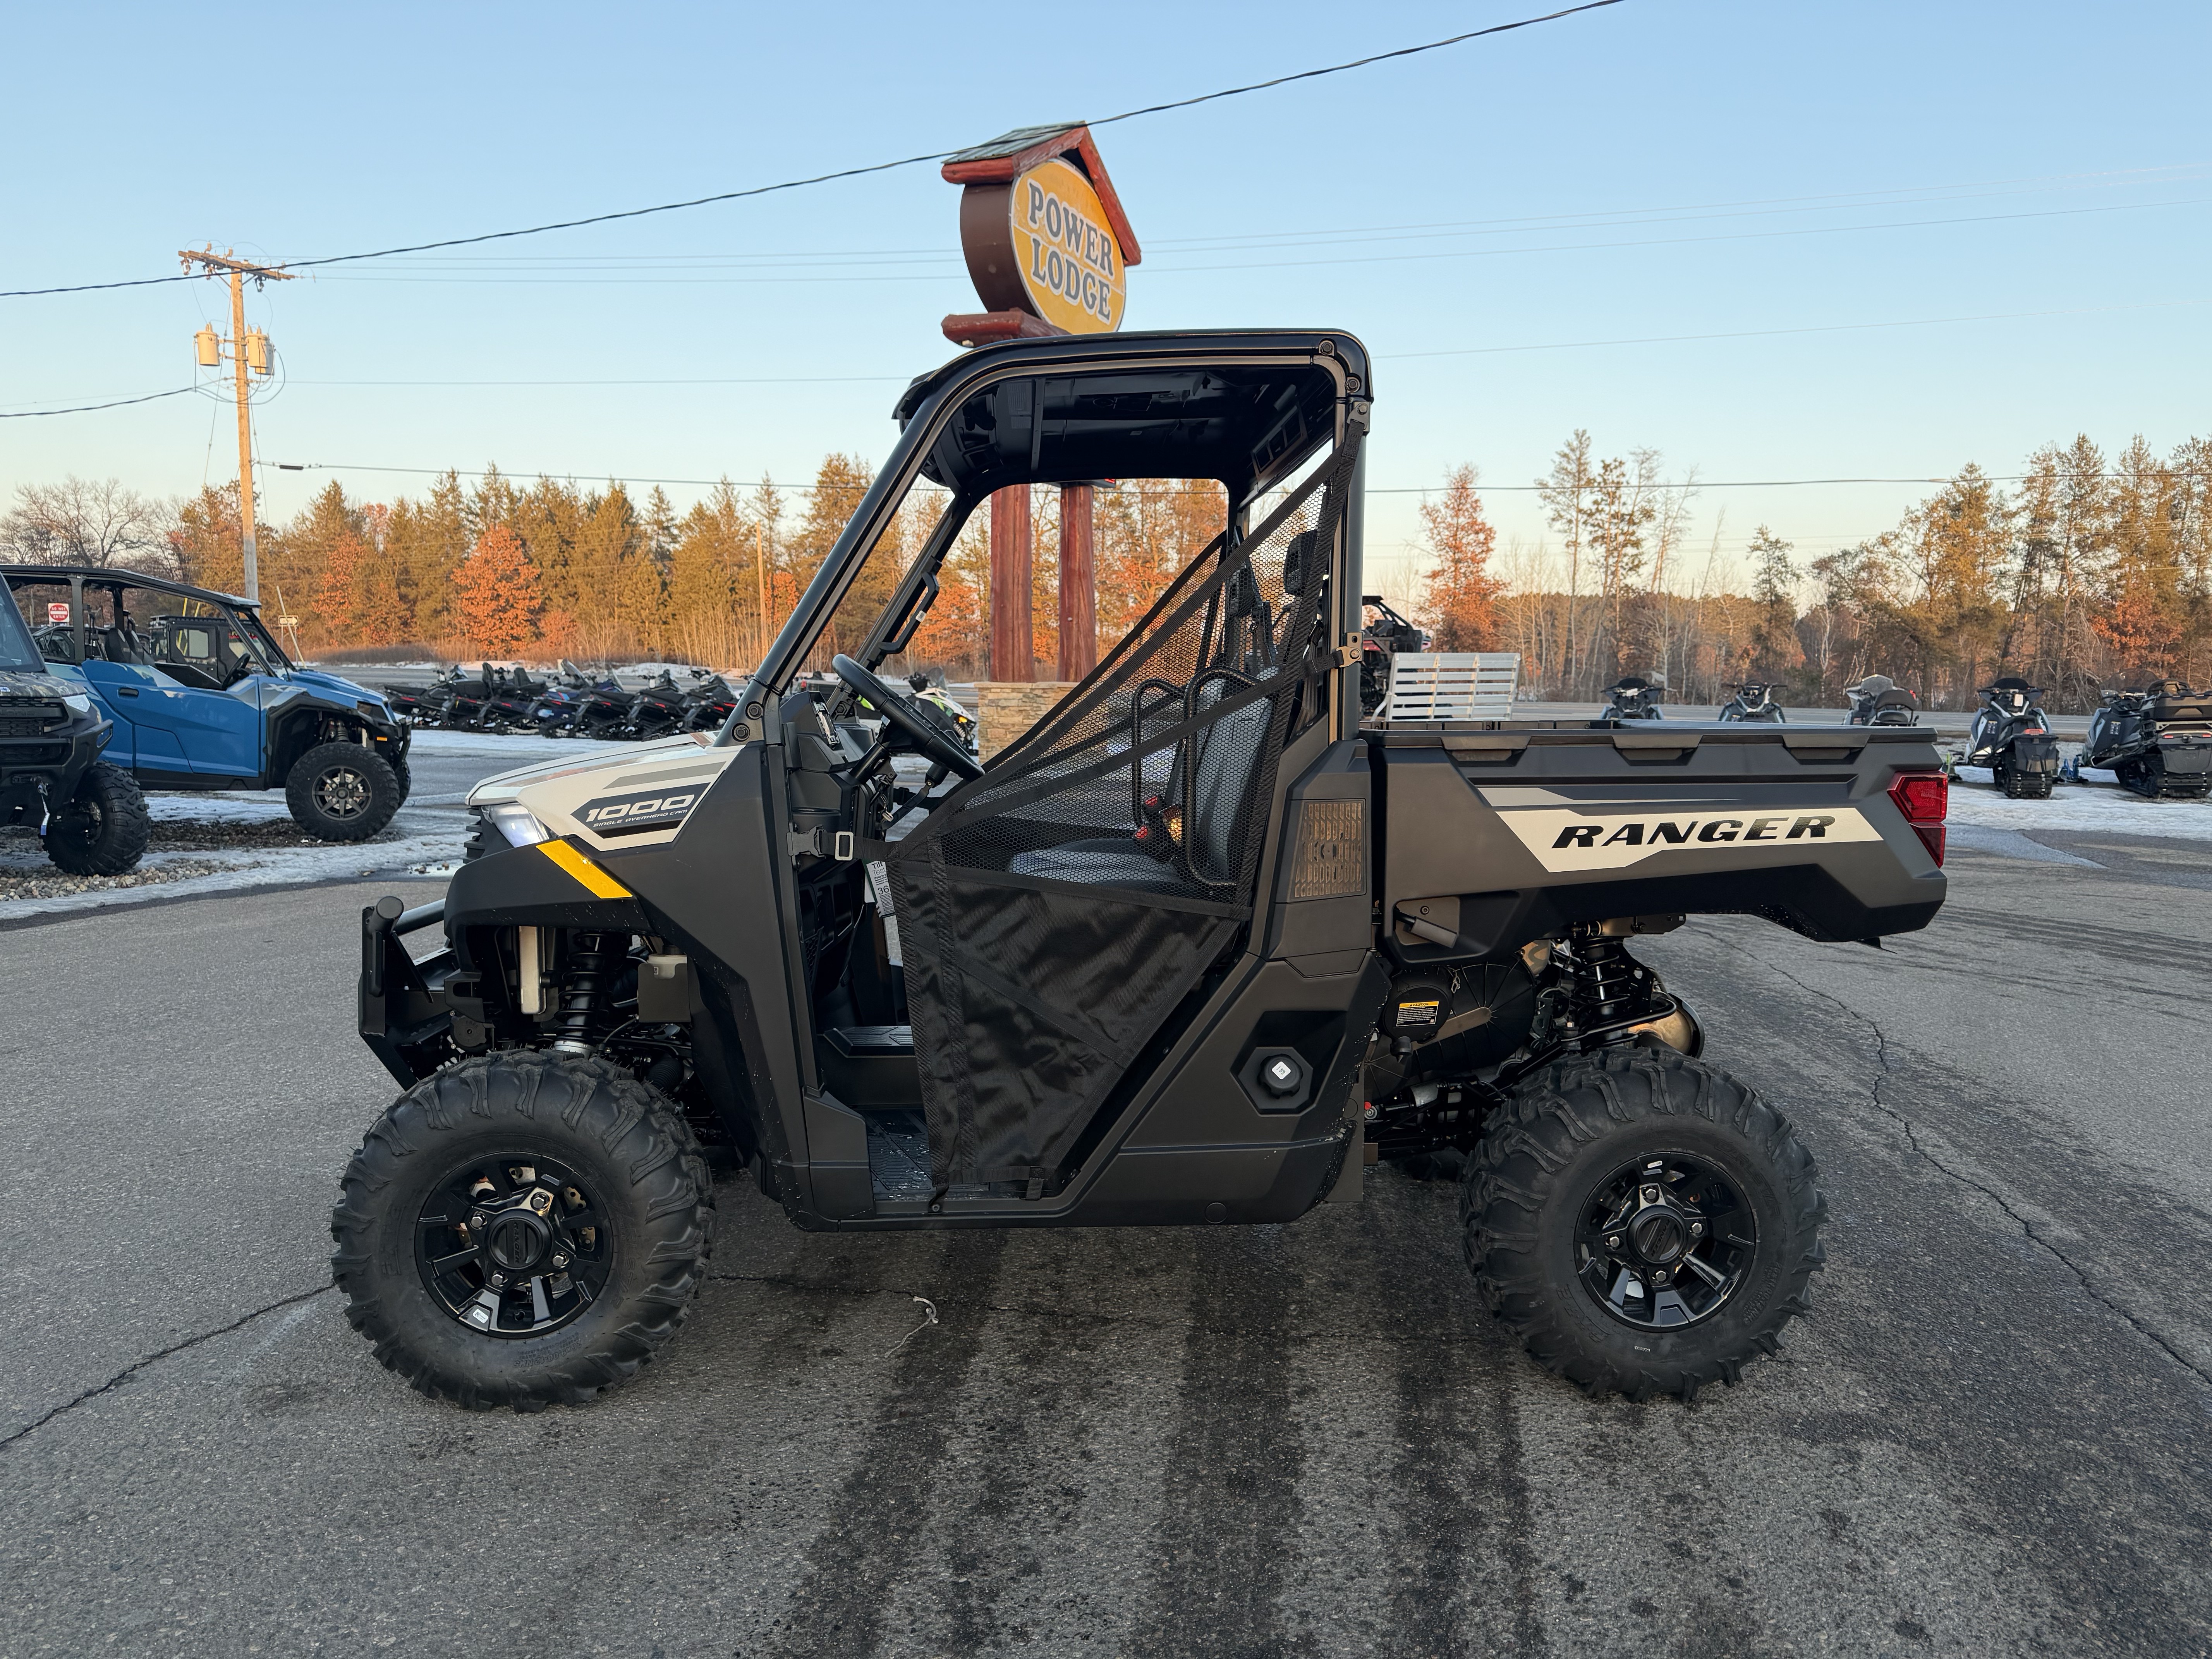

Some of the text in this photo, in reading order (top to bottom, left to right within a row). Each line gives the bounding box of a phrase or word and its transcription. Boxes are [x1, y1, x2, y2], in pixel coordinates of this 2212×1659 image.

[1028, 180, 1114, 278] POWER
[1031, 235, 1112, 323] LODGE
[586, 794, 695, 822] 1000
[593, 819, 623, 827] SINGLE
[625, 812, 668, 822] OVERHEAD
[1551, 816, 1836, 849] RANGER
[878, 885, 890, 895] 36
